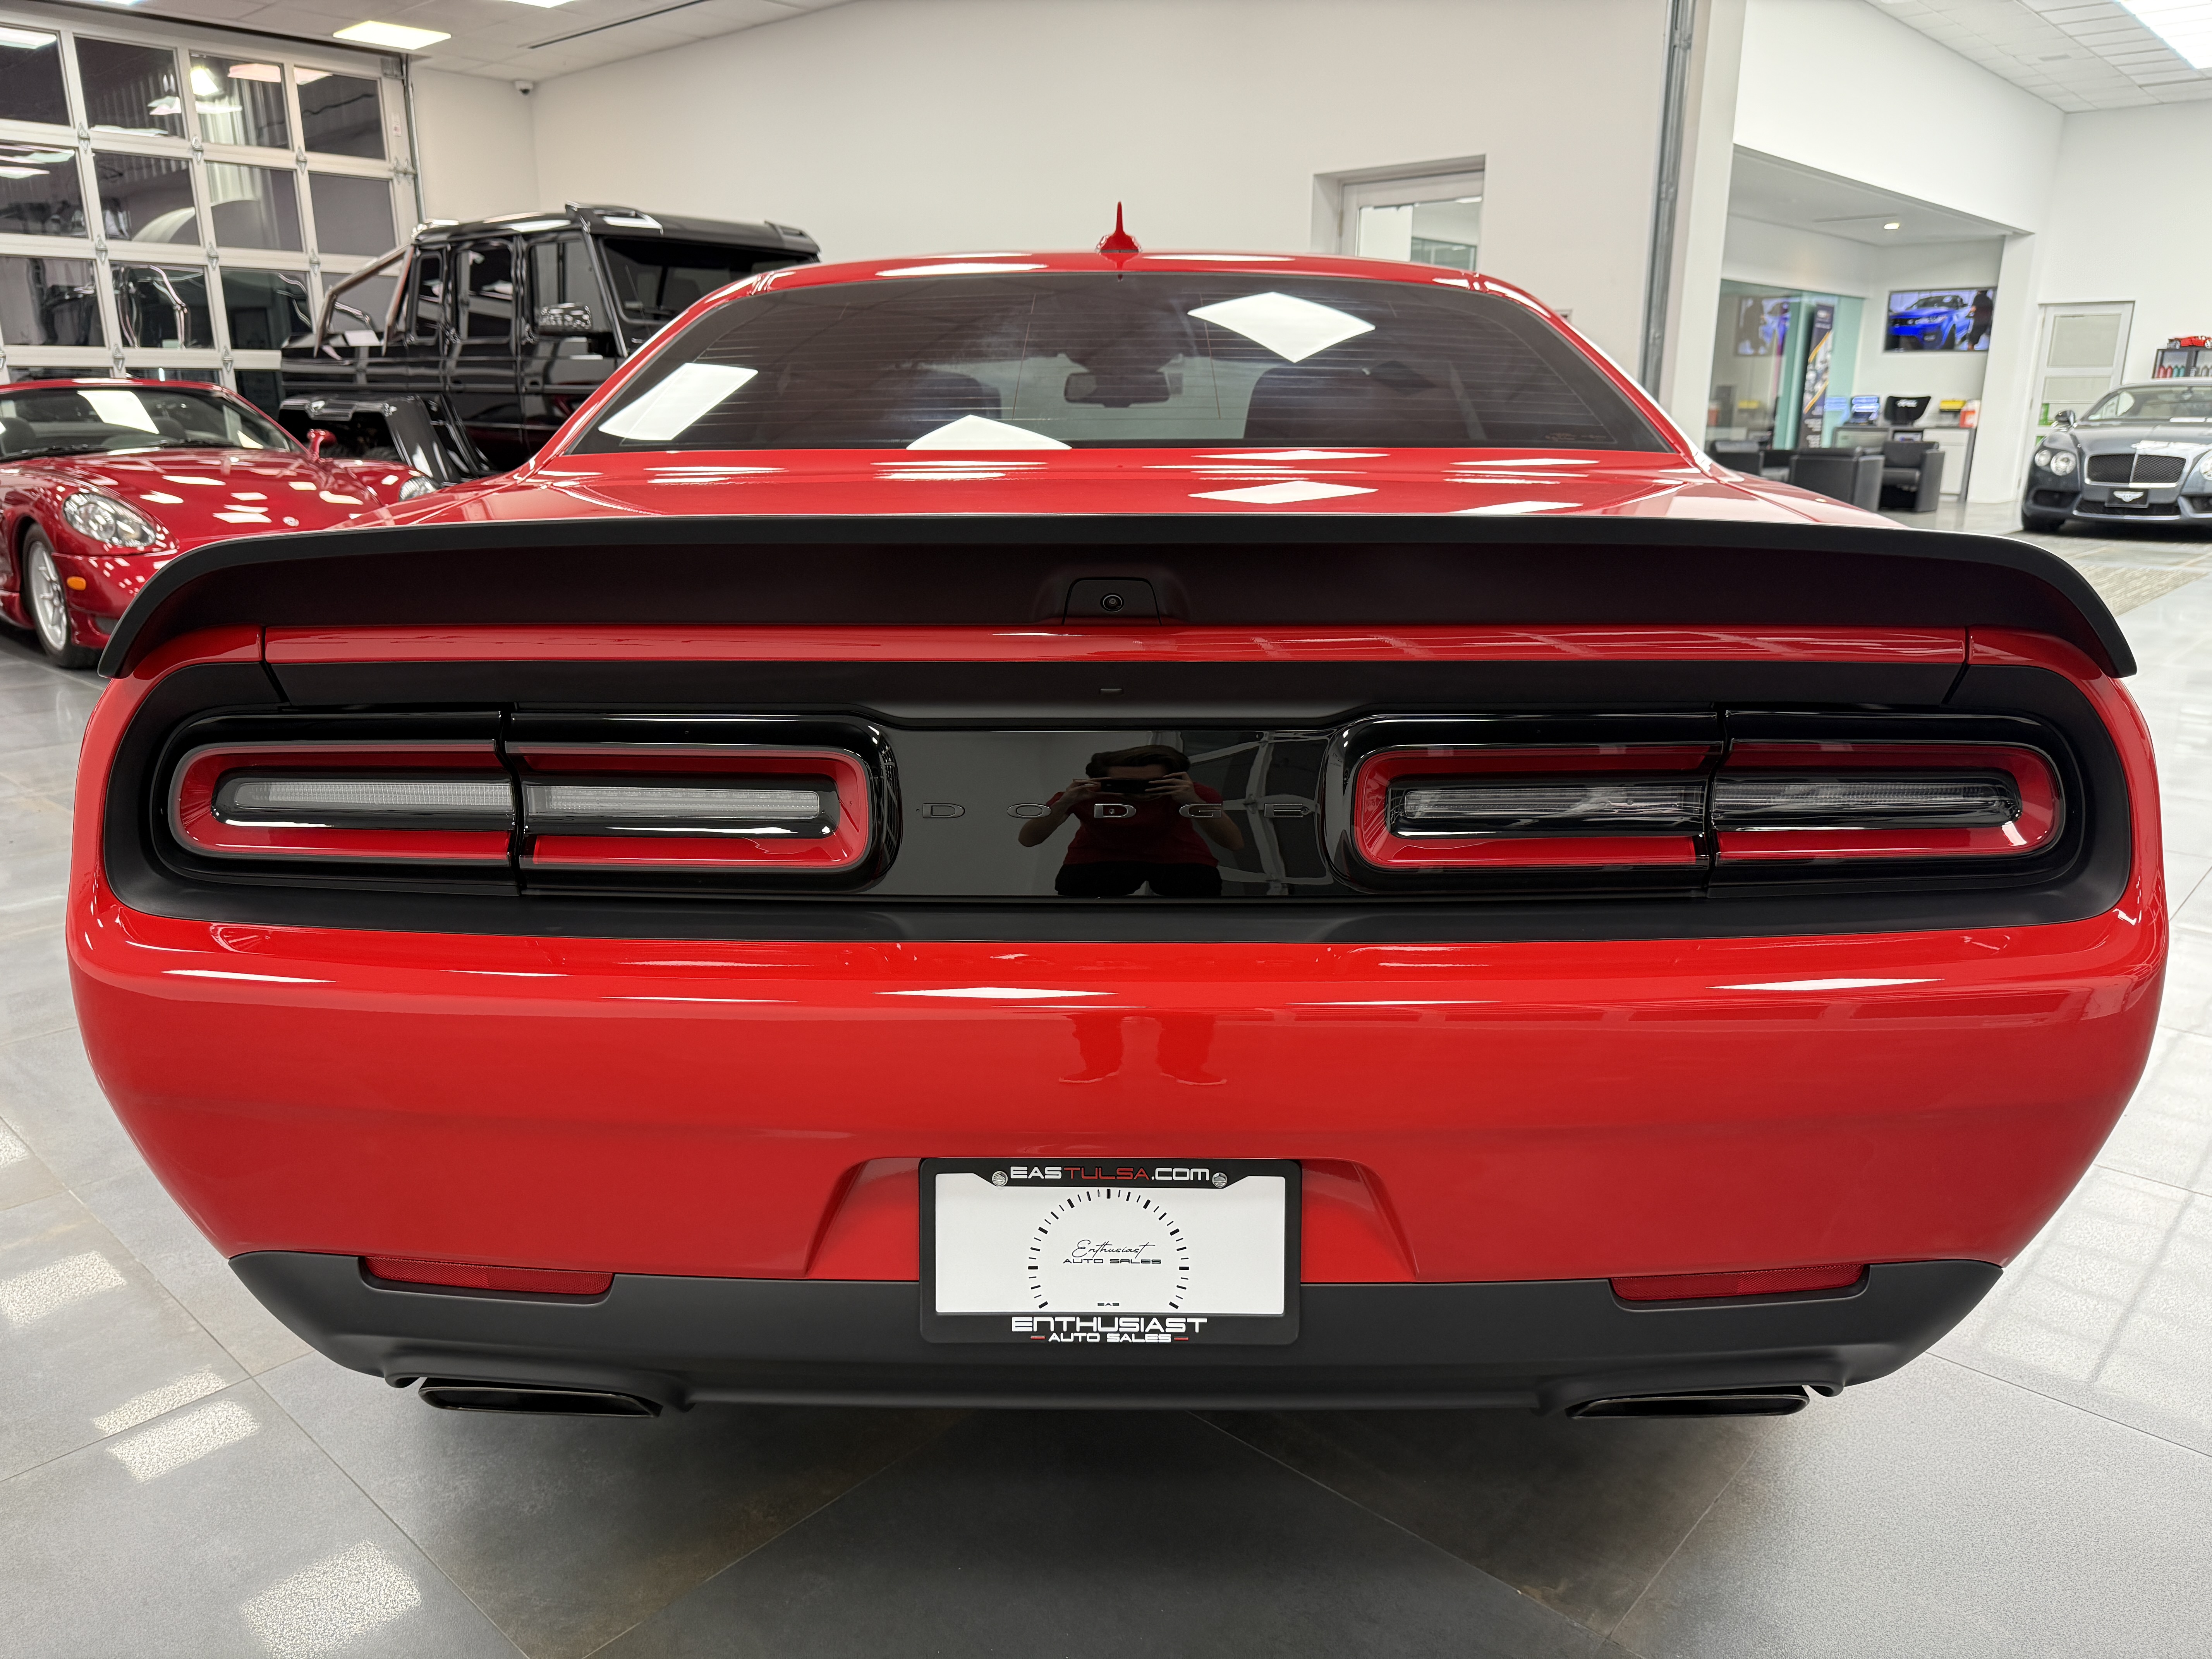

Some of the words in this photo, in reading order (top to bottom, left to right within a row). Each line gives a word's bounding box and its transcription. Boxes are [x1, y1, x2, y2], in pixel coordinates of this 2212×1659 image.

[922, 803, 1303, 818] DODGE
[1010, 1166, 1209, 1181] EASTULSA.COM
[1072, 1239, 1156, 1259] Enthusiast
[1012, 1317, 1207, 1333] ENTHUSIAST
[1048, 1333, 1100, 1342] AUTO
[1106, 1333, 1171, 1343] SALES
